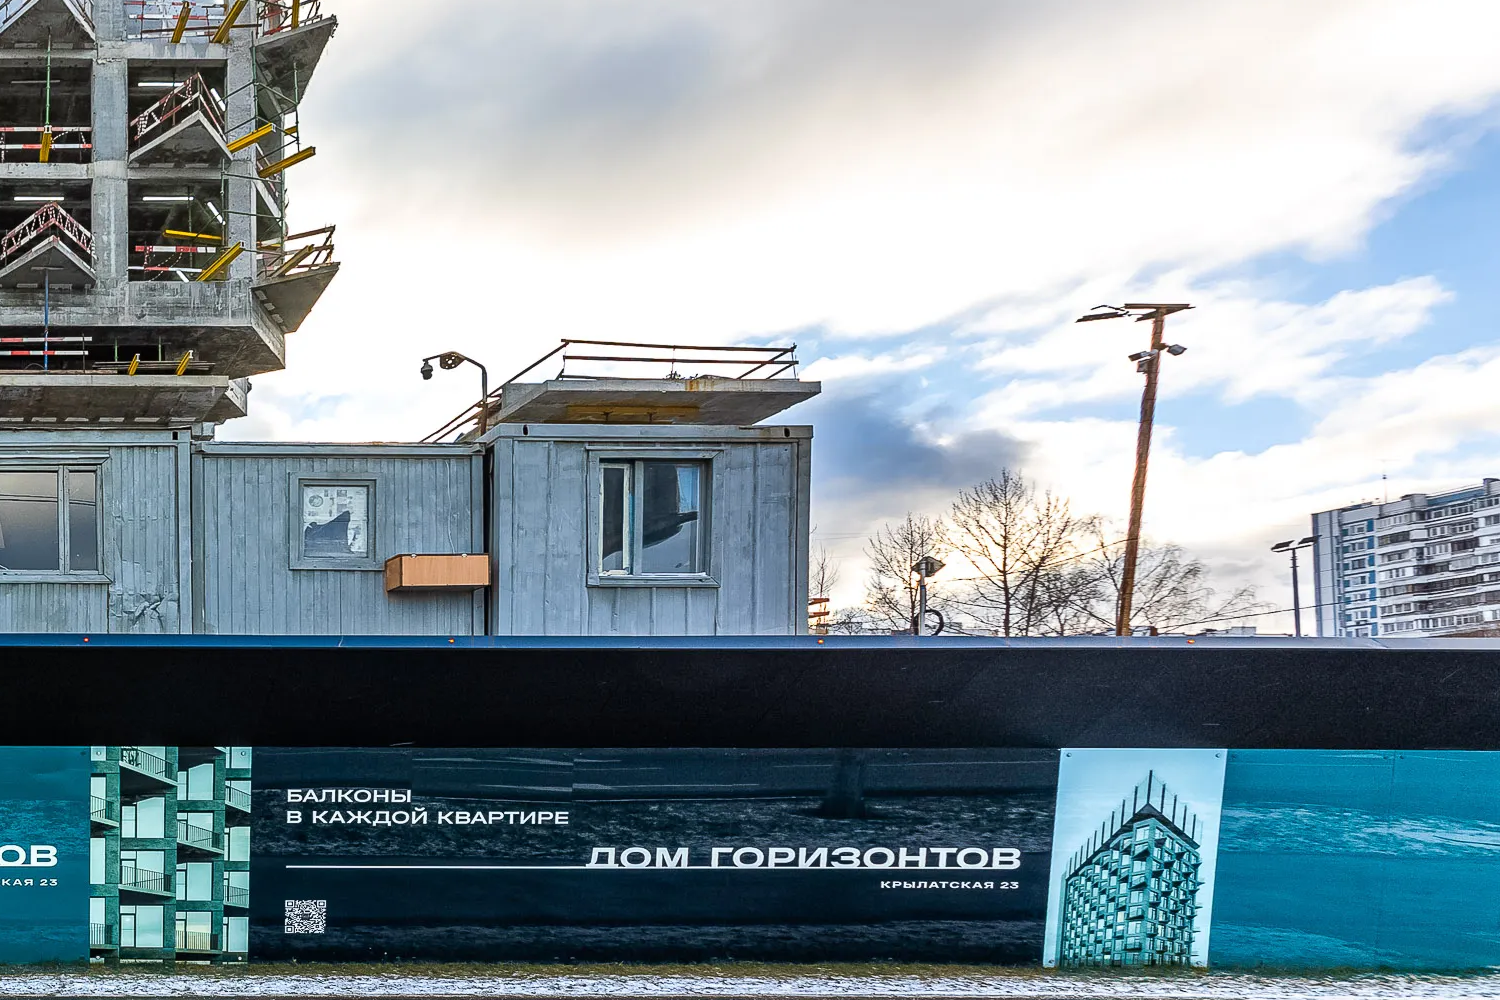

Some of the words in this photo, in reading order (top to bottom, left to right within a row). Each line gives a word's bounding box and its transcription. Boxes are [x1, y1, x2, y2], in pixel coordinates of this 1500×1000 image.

[287, 789, 412, 803] БАЛКОНЫ
[286, 810, 302, 824] В
[312, 807, 428, 827] КАЖДОЙ
[437, 811, 569, 825] КВАРТИРЕ
[586, 847, 688, 868] ДОМ
[711, 847, 1021, 870] ГОРИЗОНТОВ
[39, 878, 58, 886] 23
[880, 881, 994, 889] КРЫЛАТСКАЯ
[999, 881, 1019, 889] 23
